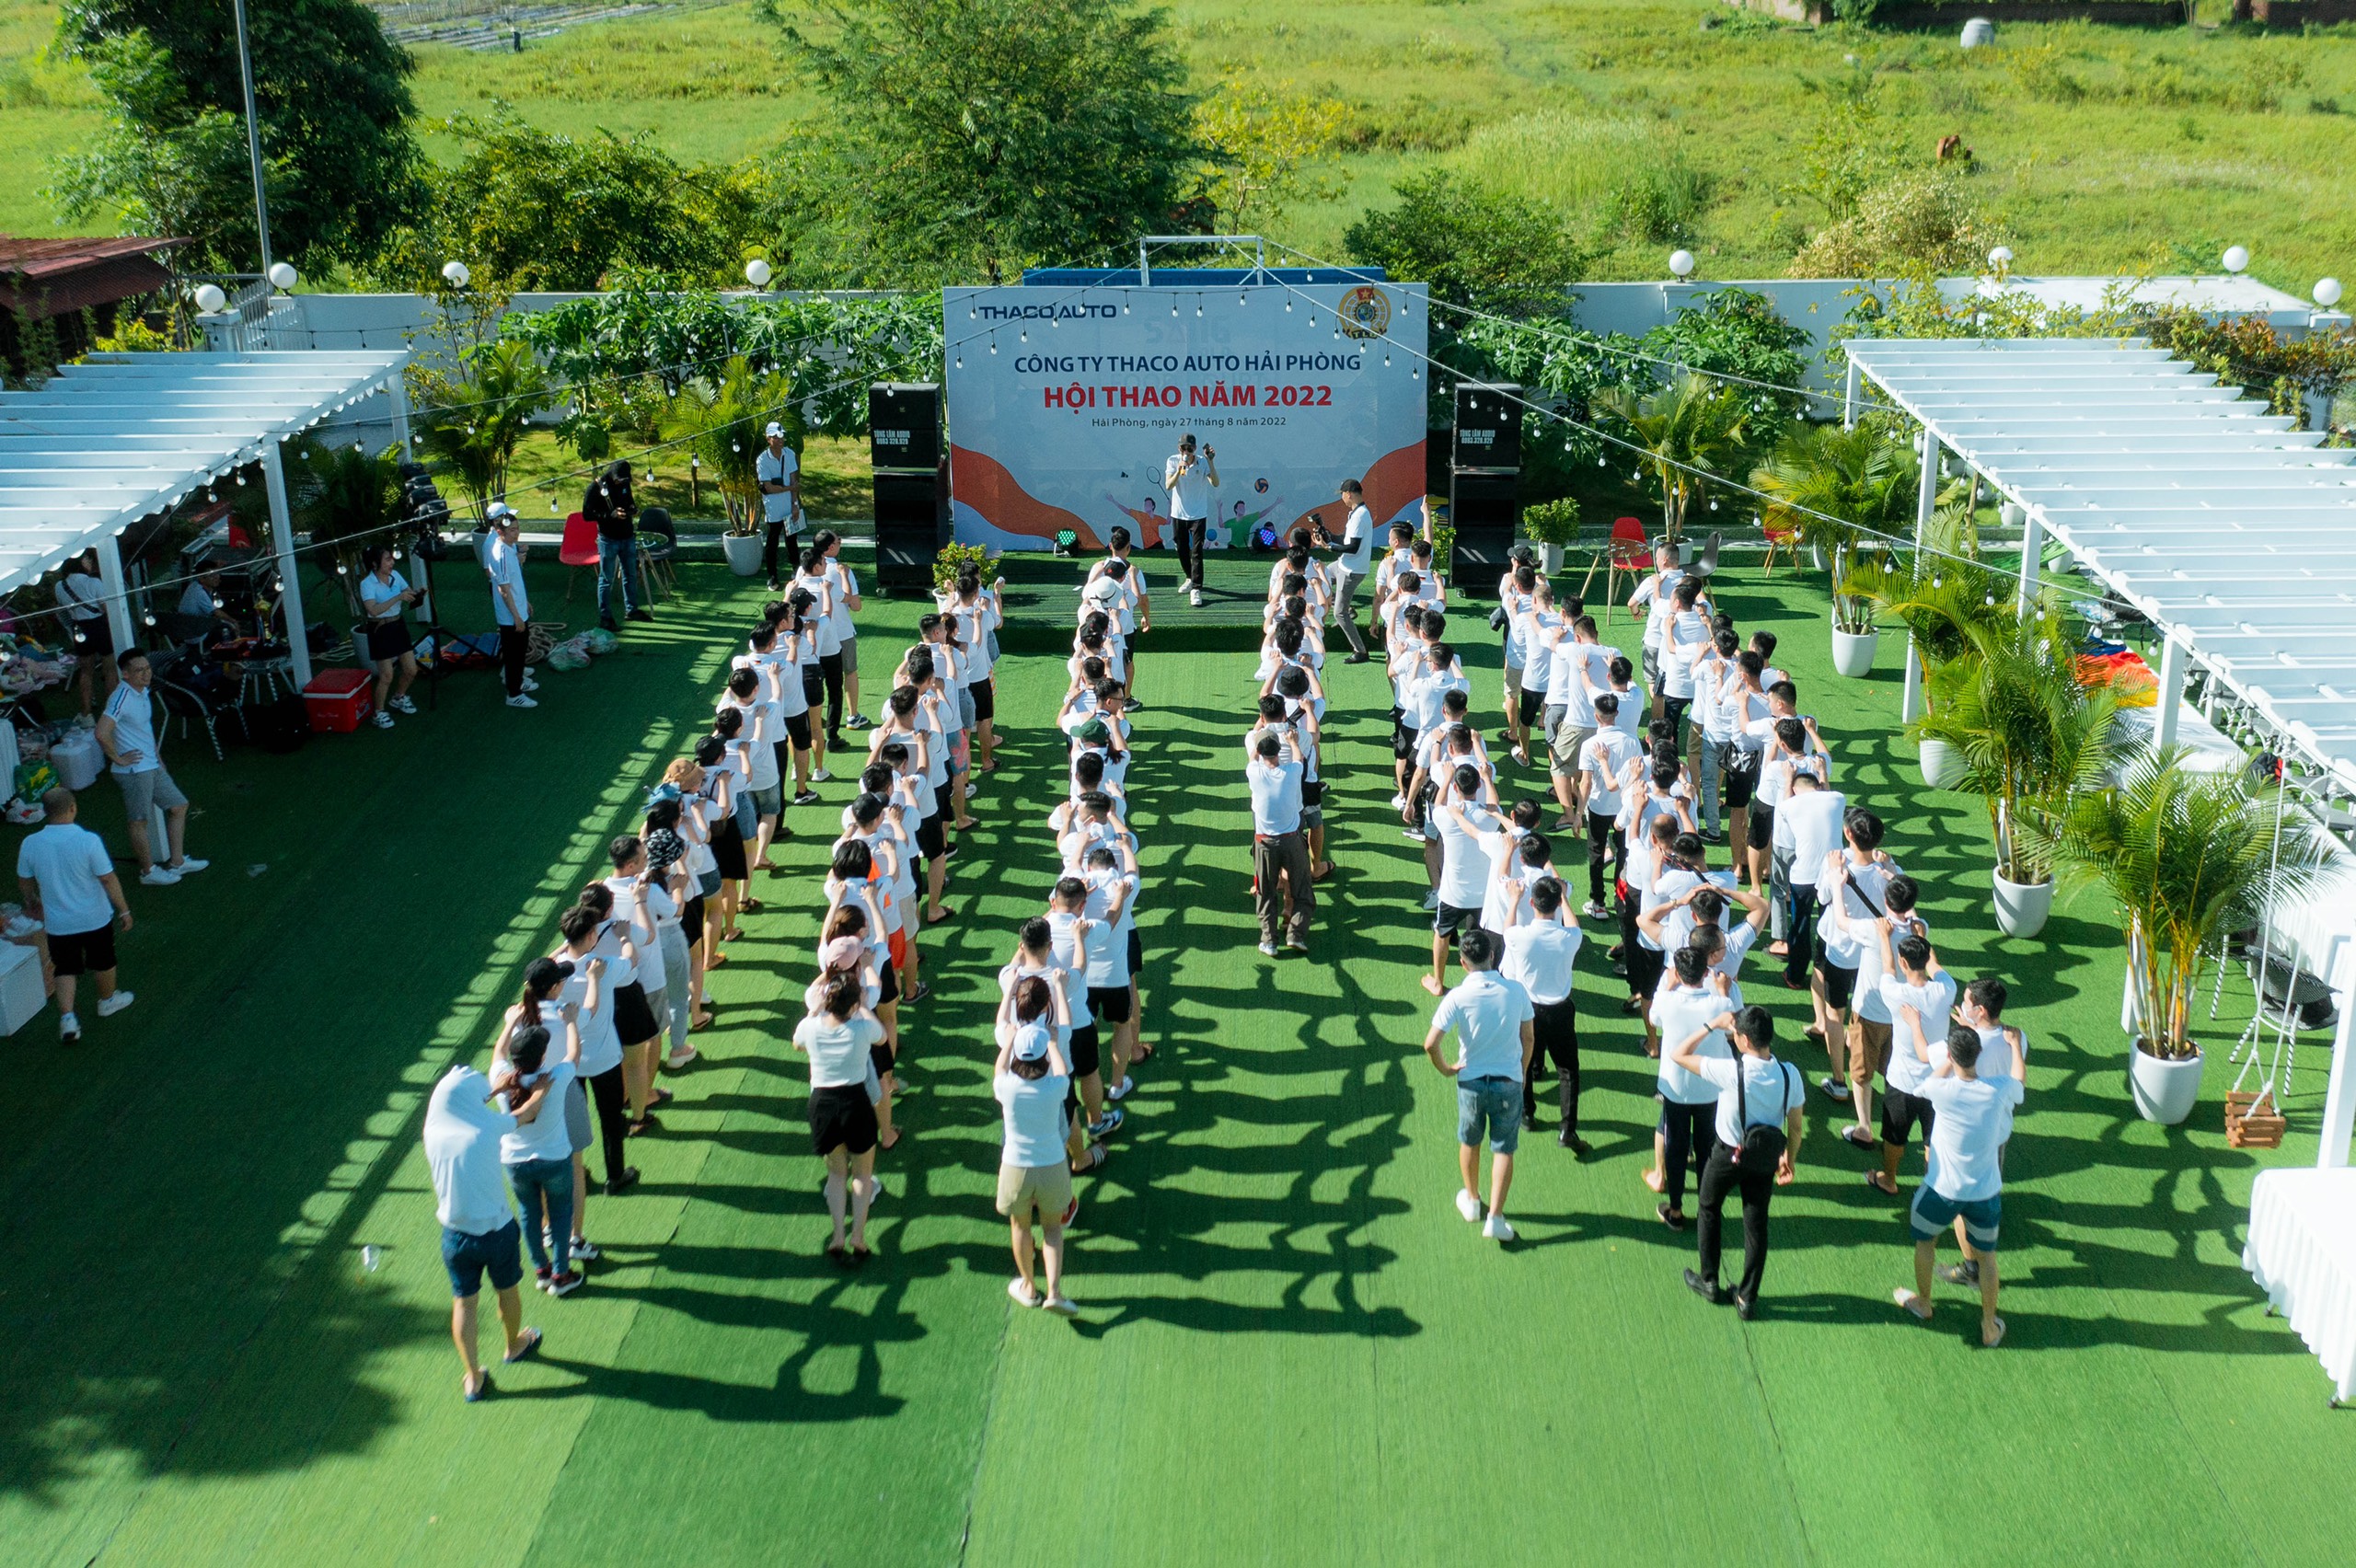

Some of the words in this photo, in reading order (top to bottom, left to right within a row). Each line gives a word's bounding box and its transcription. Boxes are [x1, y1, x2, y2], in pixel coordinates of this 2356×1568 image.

[979, 306, 1054, 319] THACO
[1057, 305, 1117, 318] AUTO
[1014, 353, 1074, 373] CÔNG
[1078, 356, 1103, 372] TY
[1107, 355, 1179, 372] THACO
[1184, 355, 1240, 372] AUTO
[1245, 350, 1280, 371] HẢI
[1287, 352, 1361, 371] PHÒNG
[1044, 382, 1095, 414] HỘI
[1102, 386, 1182, 408] THAO
[1190, 380, 1256, 407] NĂM
[1264, 385, 1332, 407] 2022
[1091, 418, 1110, 427] Hải
[1112, 418, 1149, 429] Phòng,
[1151, 418, 1177, 429] ngày
[1179, 418, 1192, 427] 27
[1194, 417, 1225, 428] tháng
[1227, 417, 1234, 426] 8
[1236, 417, 1258, 426] năm
[1260, 417, 1287, 426] 2022
